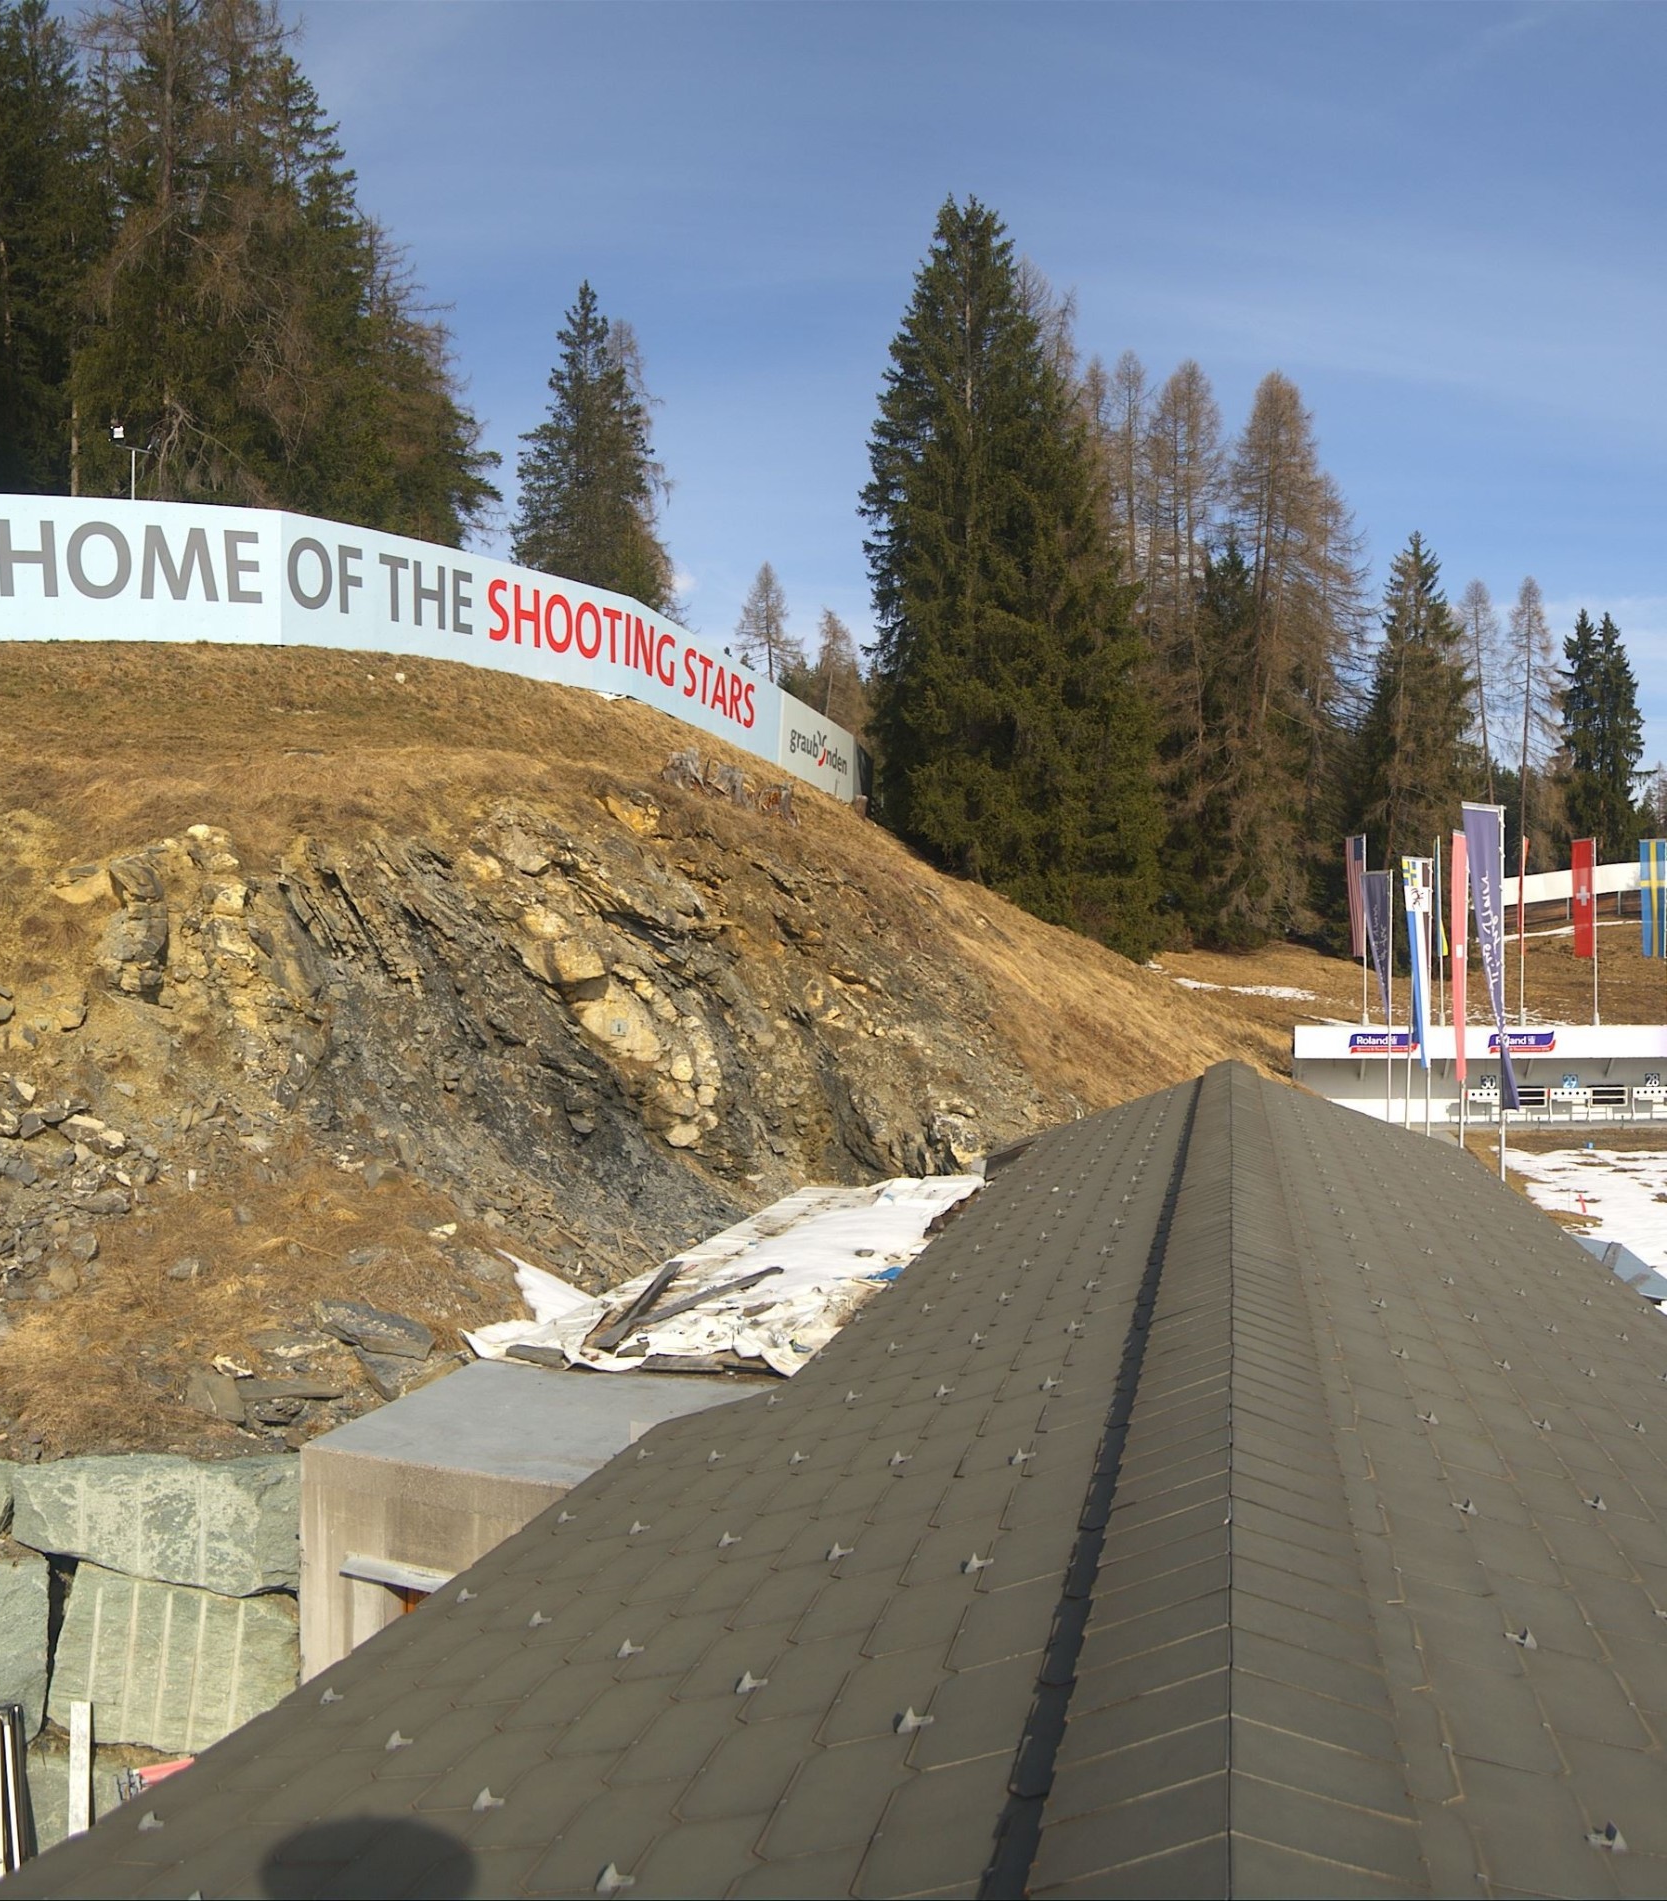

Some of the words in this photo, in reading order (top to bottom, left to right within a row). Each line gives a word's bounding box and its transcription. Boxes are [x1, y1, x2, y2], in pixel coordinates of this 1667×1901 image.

[287, 537, 363, 614] OF
[378, 552, 474, 635] THE
[487, 578, 676, 687] SHOOTING
[683, 647, 756, 729] STARS
[1357, 1036, 1388, 1045] Roland
[1496, 1036, 1527, 1045] Rland
[1481, 1075, 1496, 1089] 30
[1563, 1074, 1577, 1088] 29
[1645, 1073, 1659, 1086] 28
